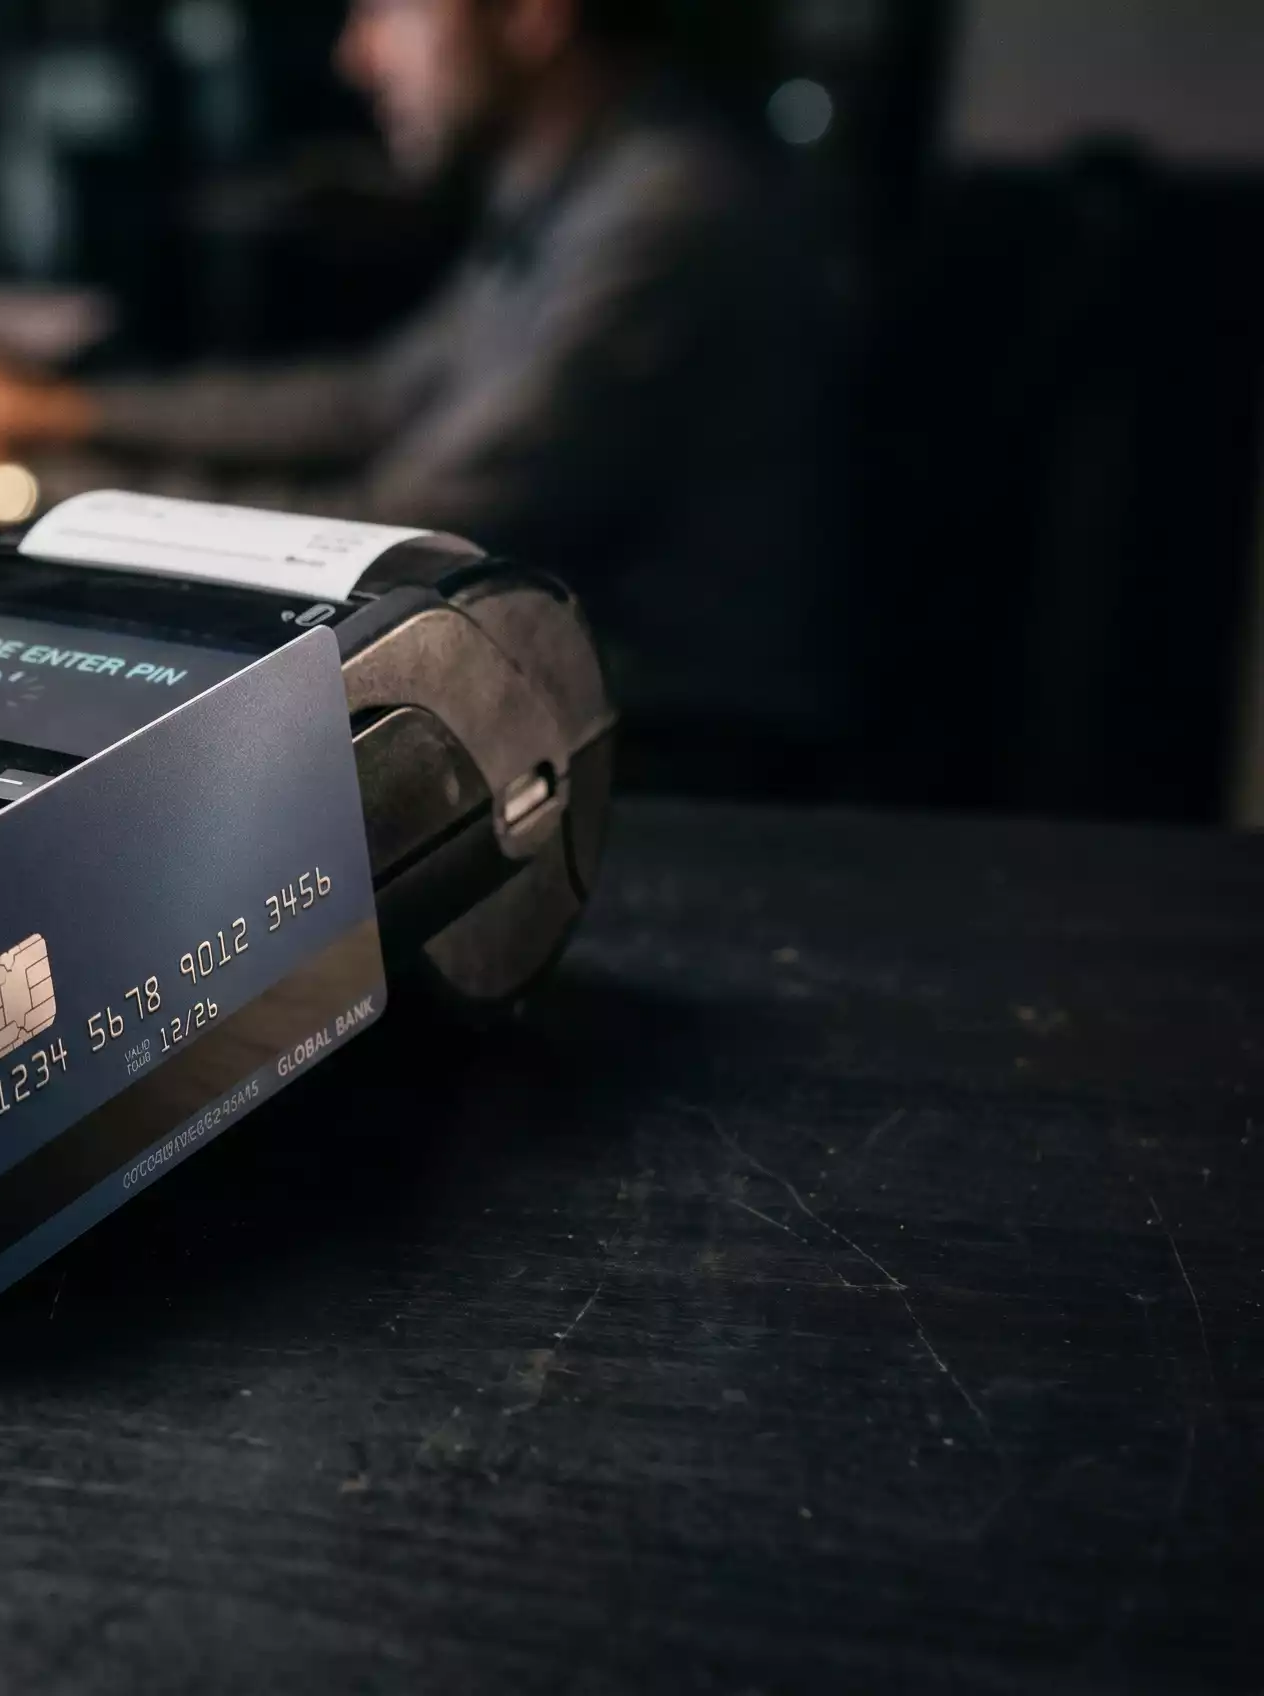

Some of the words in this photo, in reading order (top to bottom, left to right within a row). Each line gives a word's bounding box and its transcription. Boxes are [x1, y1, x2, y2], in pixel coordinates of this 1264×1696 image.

[19, 644, 125, 677] ENTER
[125, 662, 189, 687] PIN
[87, 975, 162, 1052] 5678
[179, 916, 249, 985] 9012
[265, 866, 332, 932] 3456
[160, 997, 218, 1053] 12/26
[277, 1027, 333, 1077] GLOBAL
[335, 994, 375, 1037] BANK
